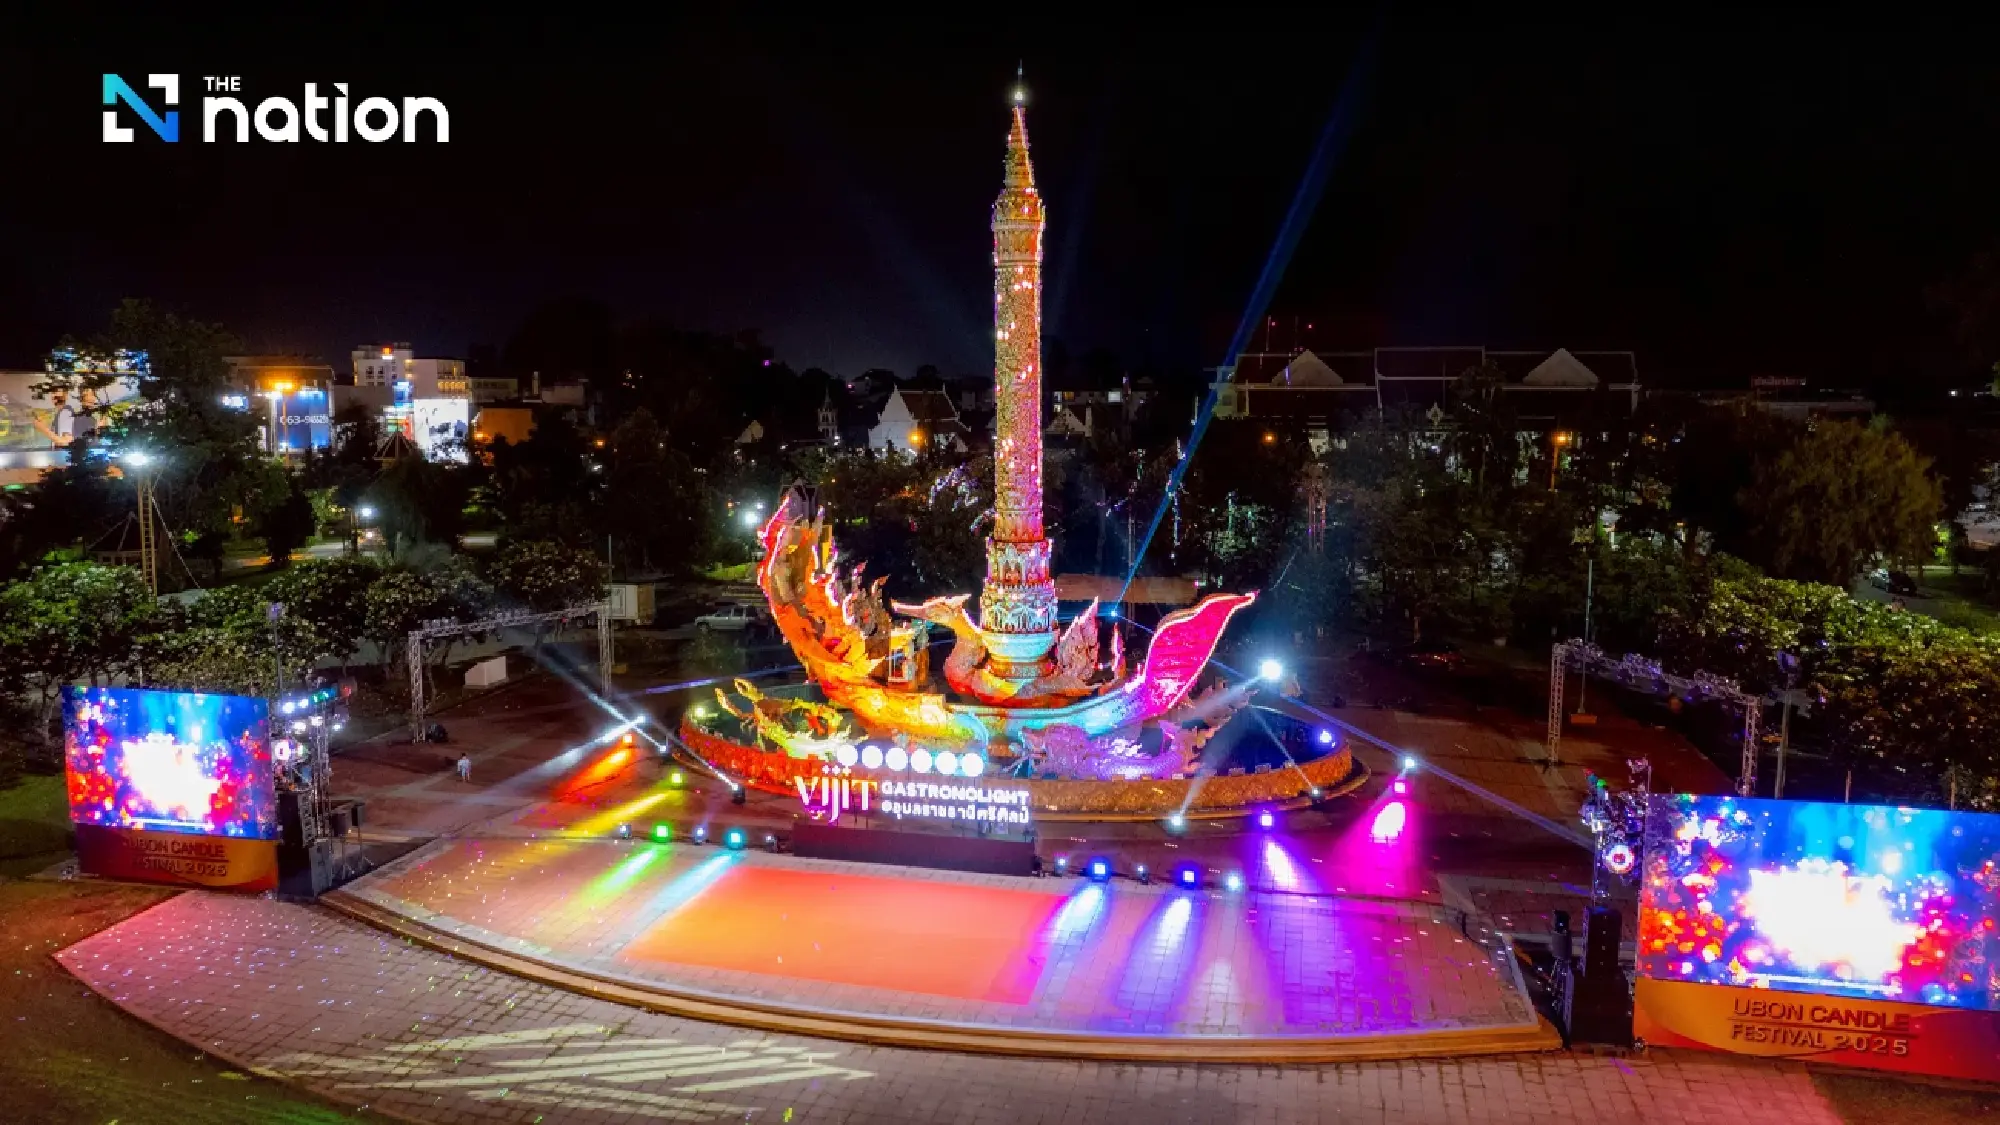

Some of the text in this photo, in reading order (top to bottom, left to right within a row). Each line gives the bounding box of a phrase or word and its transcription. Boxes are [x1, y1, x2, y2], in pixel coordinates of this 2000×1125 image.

[881, 780, 1030, 806] GASTRONOLIGHT
[171, 839, 226, 857] CANDLE
[184, 860, 227, 877] 2025
[1734, 996, 1910, 1031] UBON CANDLE
[1732, 1024, 1908, 1056] FESTIVAL 2025
